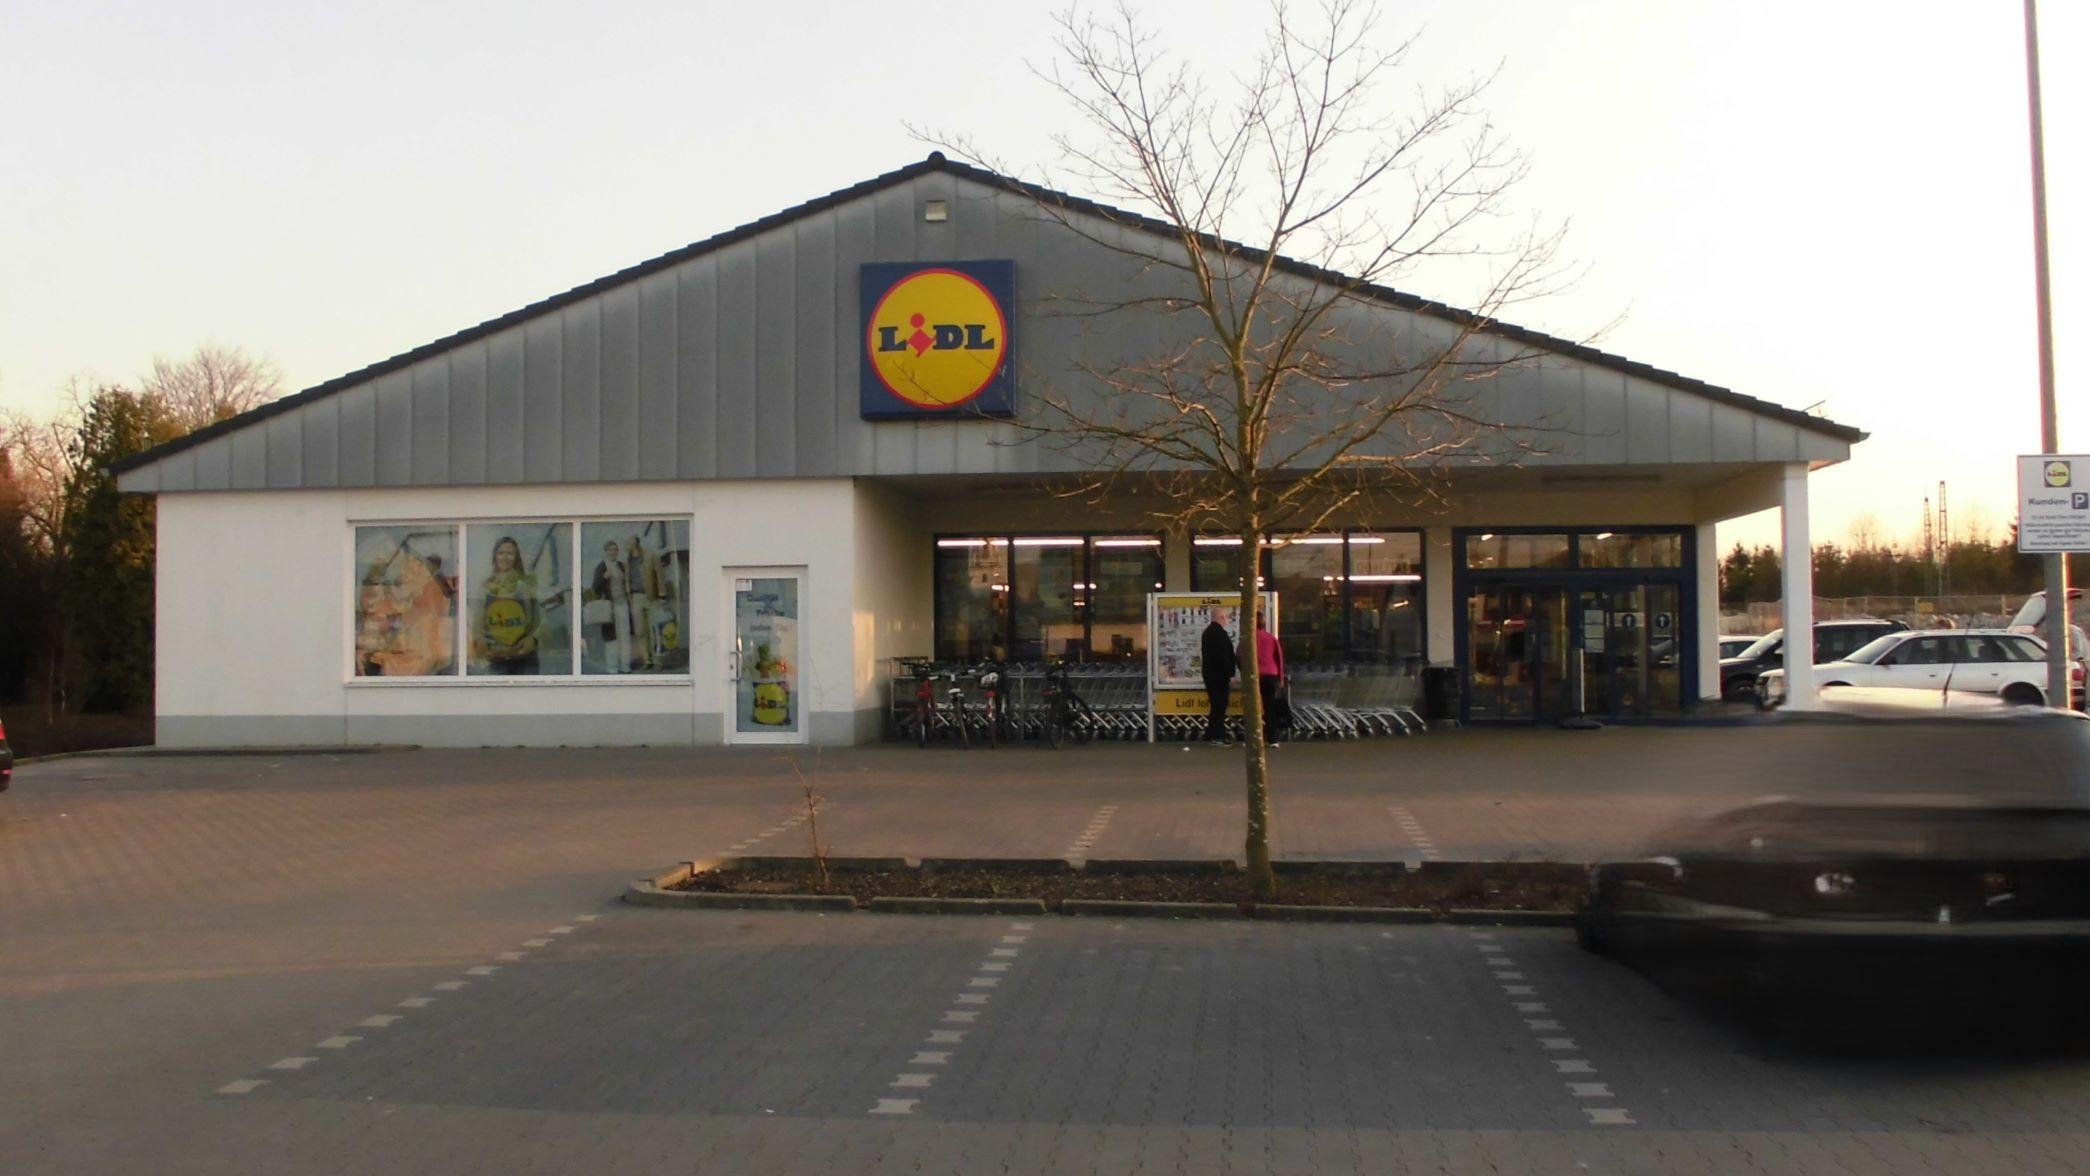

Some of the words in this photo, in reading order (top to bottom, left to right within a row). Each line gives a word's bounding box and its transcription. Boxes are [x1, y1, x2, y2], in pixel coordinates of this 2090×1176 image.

[2028, 497, 2069, 506] Kunden-
[2074, 494, 2086, 508] P
[1176, 697, 1194, 708] Lidl
